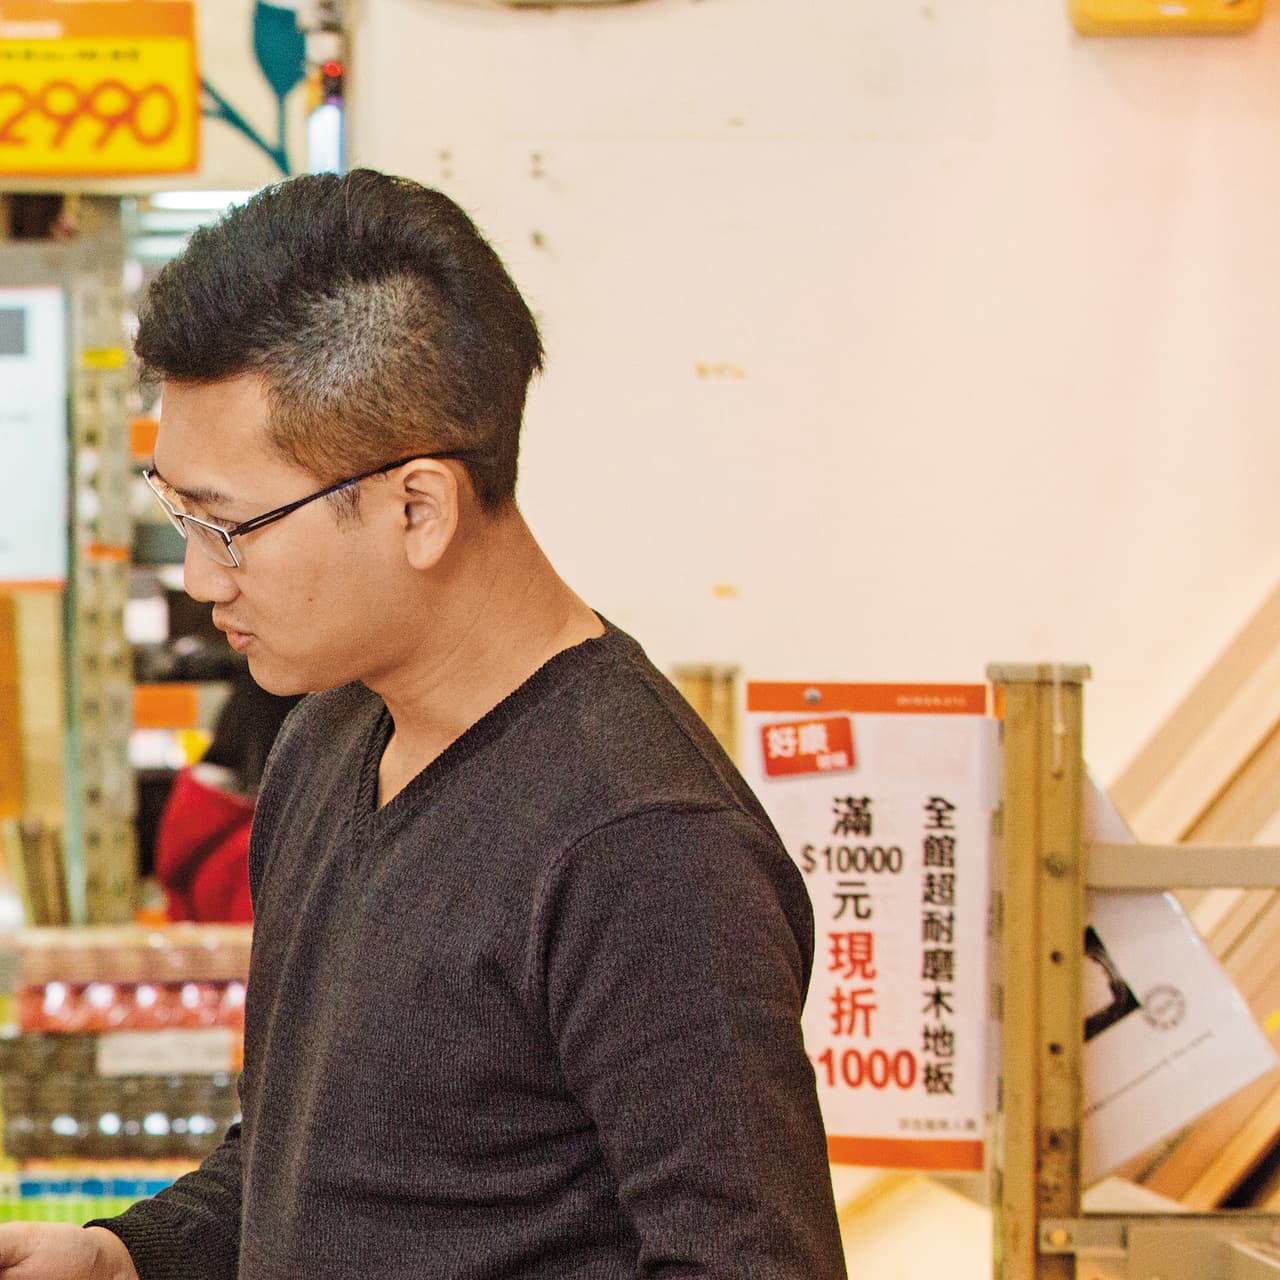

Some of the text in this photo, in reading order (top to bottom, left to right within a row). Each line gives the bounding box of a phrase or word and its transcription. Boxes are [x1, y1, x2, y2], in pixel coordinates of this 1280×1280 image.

[831, 796, 875, 838] 滿
[801, 844, 904, 876] $10000
[831, 880, 872, 922] 元
[920, 796, 958, 1097] 全館超耐磨木地板
[827, 931, 879, 1039] 現折
[808, 1048, 917, 1090] 1000
